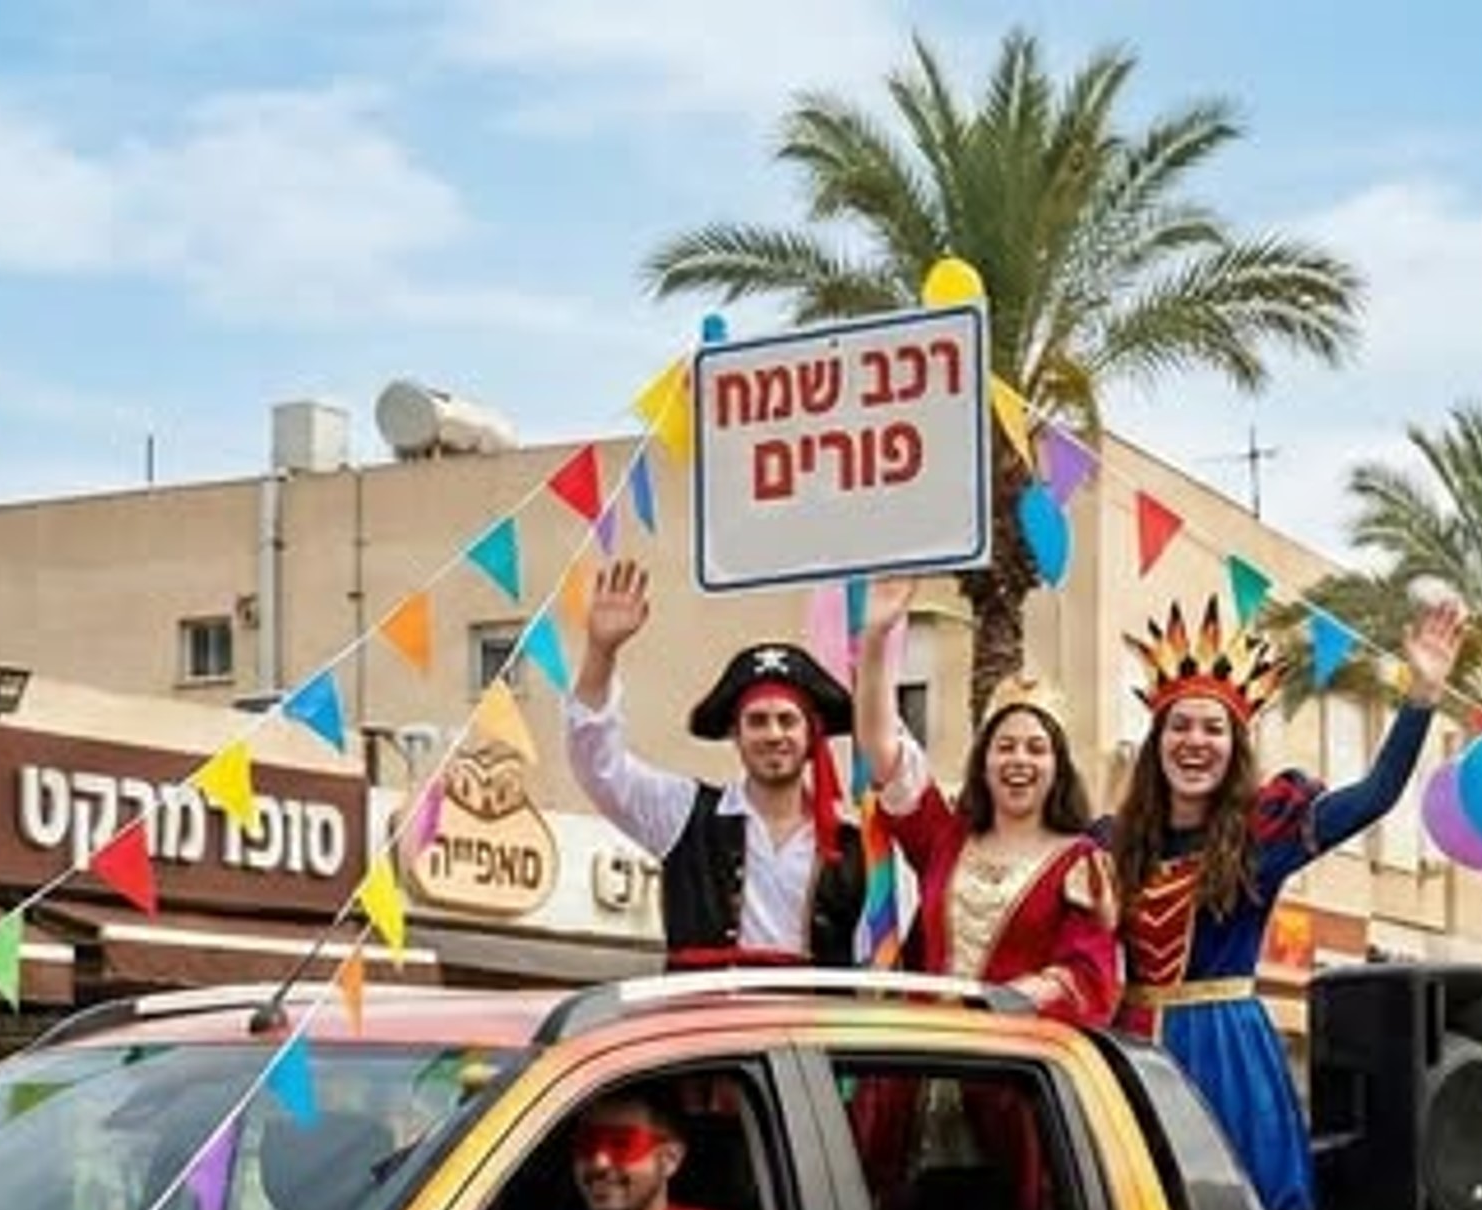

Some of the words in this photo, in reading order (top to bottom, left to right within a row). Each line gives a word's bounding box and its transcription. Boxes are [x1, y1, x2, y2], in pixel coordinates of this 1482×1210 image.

[715, 358, 841, 429] שמח
[861, 338, 961, 407] רכב
[752, 421, 923, 501] פורים
